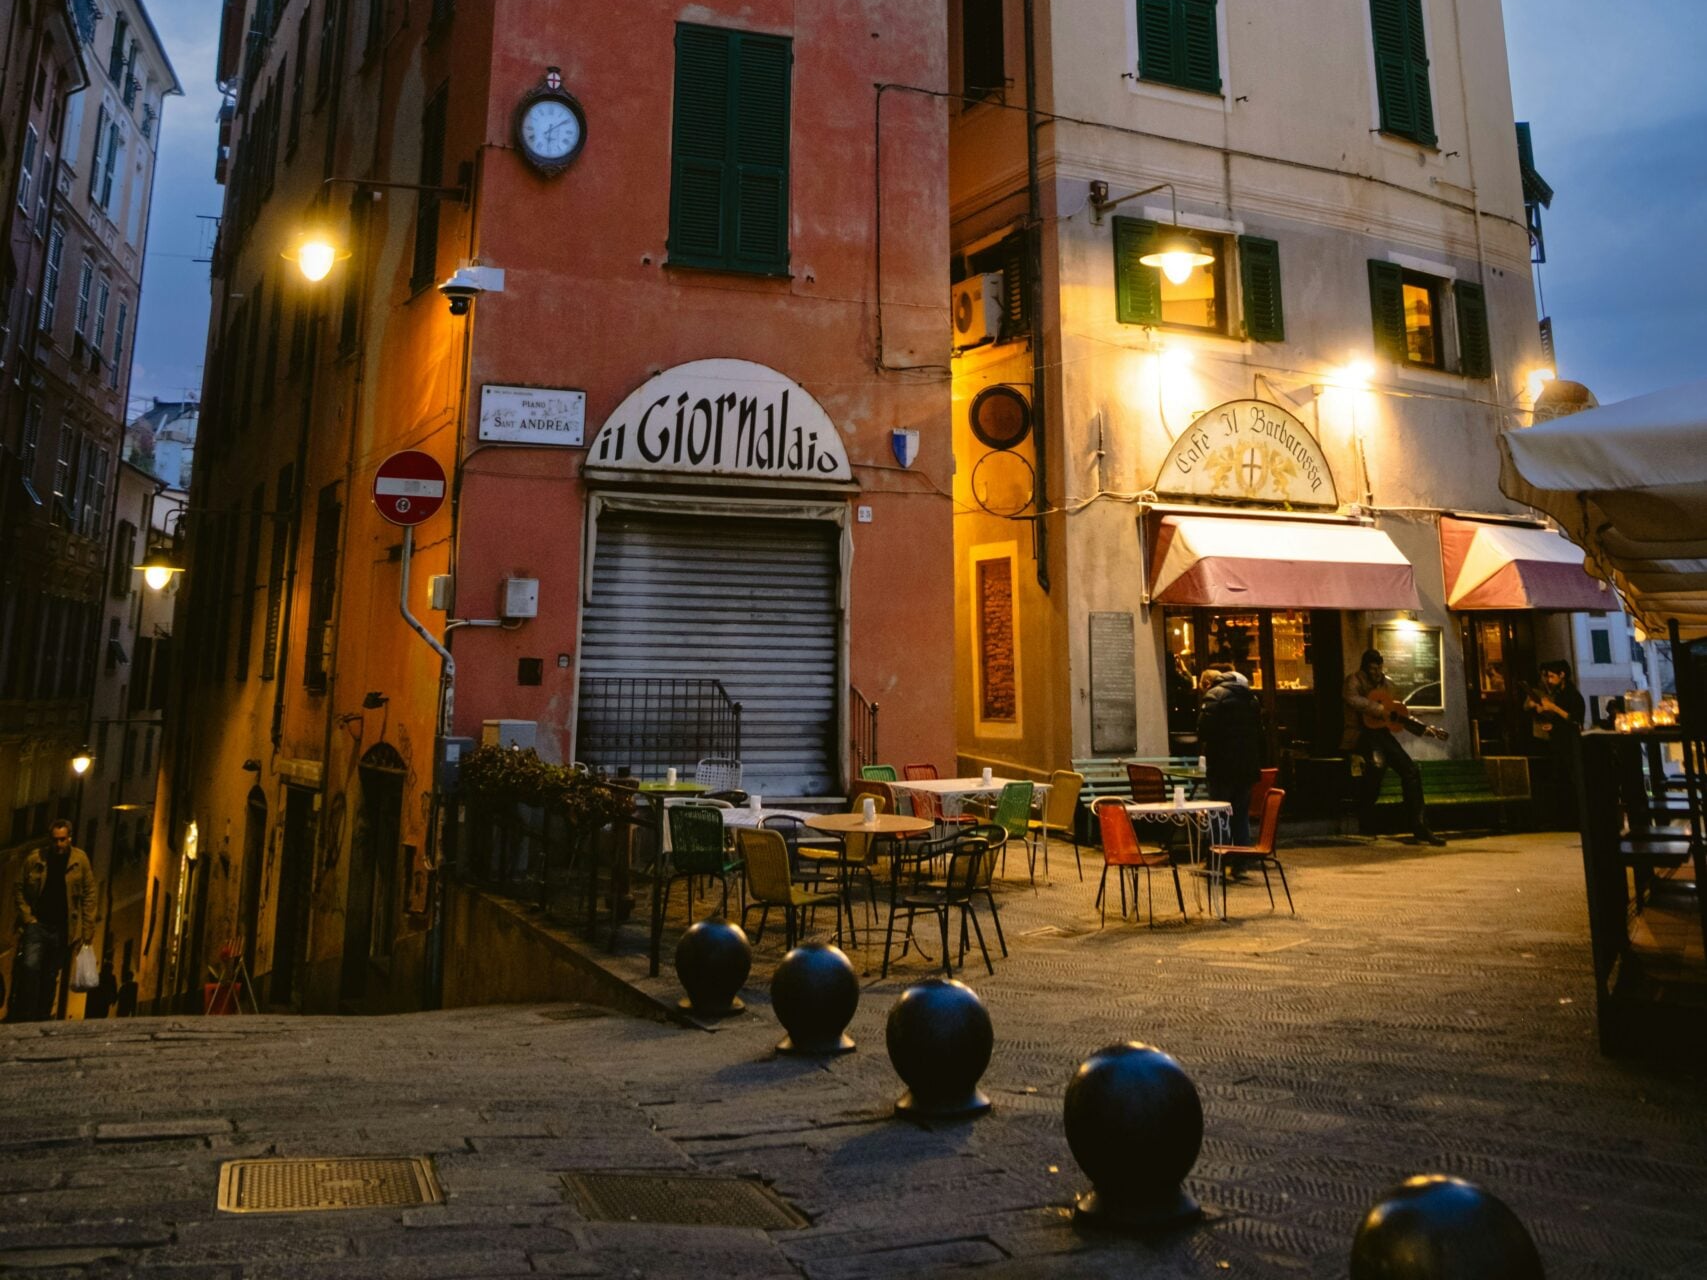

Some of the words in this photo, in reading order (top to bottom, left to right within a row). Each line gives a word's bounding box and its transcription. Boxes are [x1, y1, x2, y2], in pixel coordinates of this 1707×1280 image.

[520, 419, 570, 431] ANDREA
[522, 400, 546, 408] PIANO
[599, 423, 626, 461] il
[637, 389, 838, 473] Giornalaio
[1221, 408, 1240, 437] Il
[1250, 406, 1323, 493] Barbarossa
